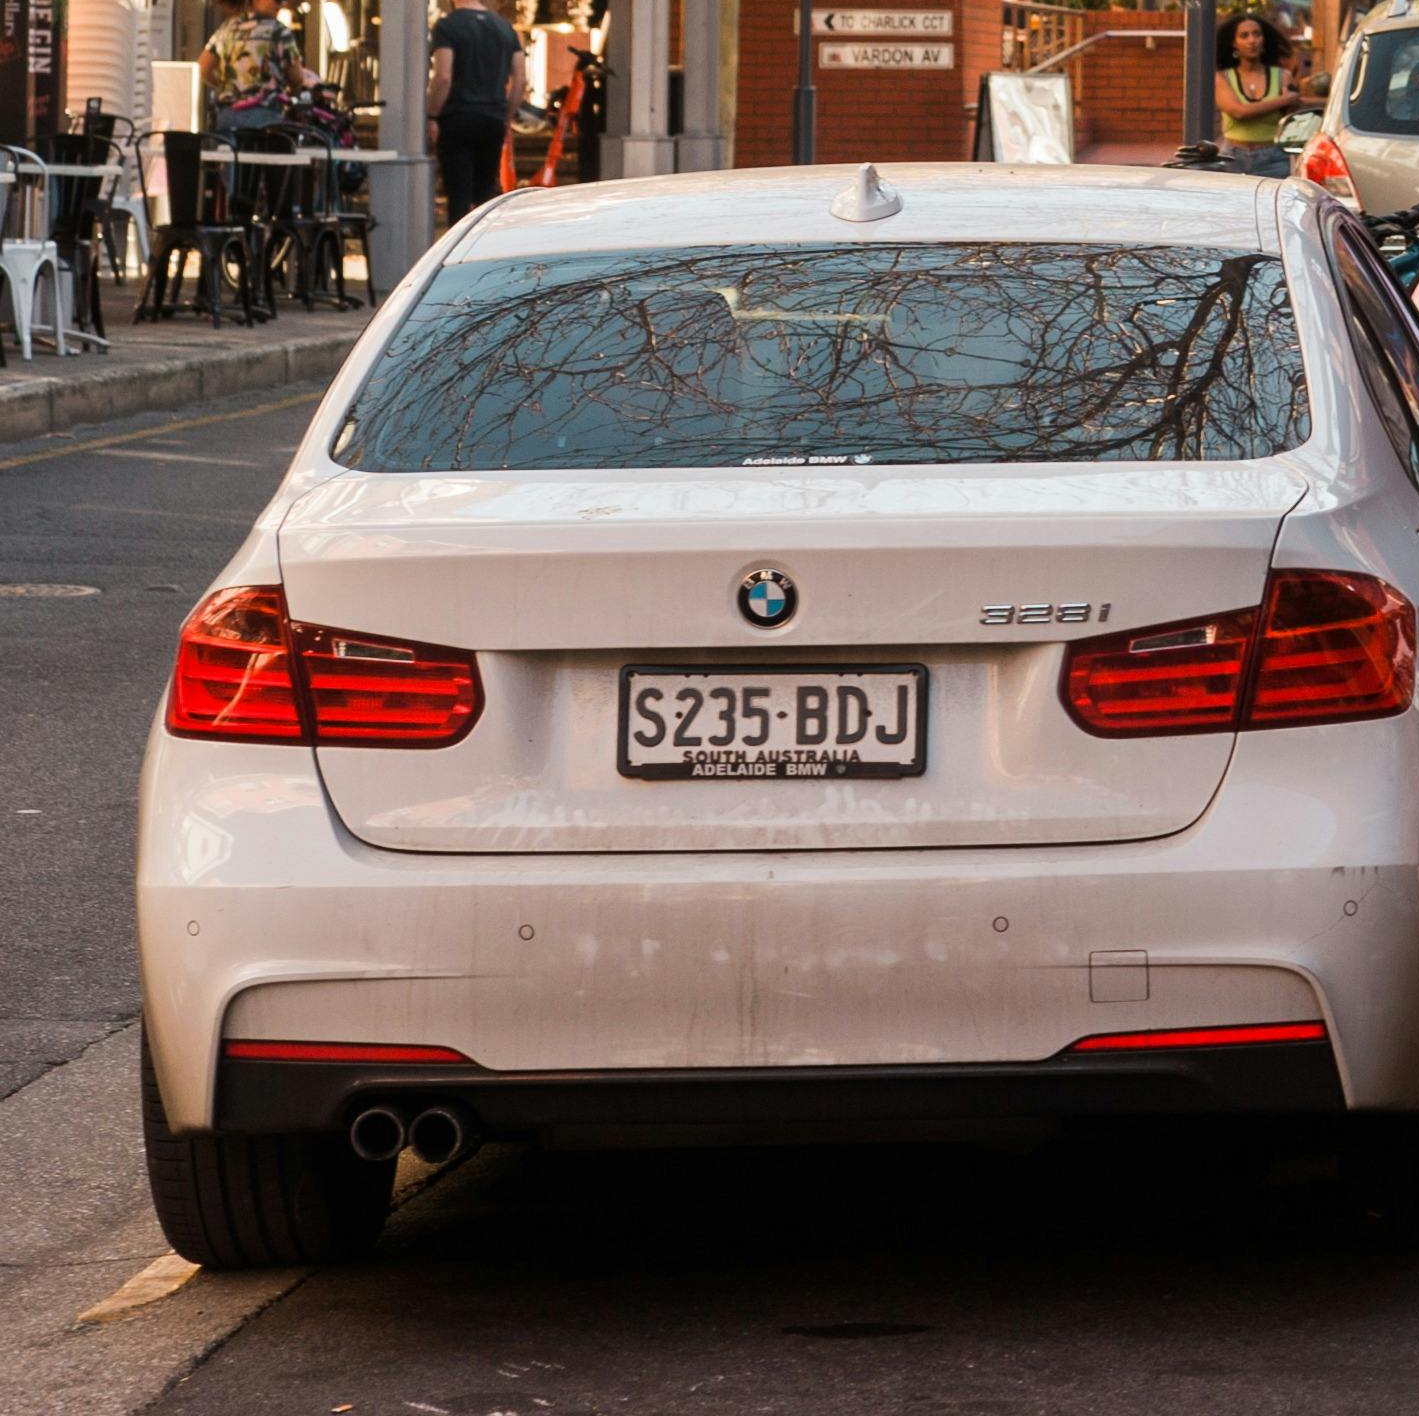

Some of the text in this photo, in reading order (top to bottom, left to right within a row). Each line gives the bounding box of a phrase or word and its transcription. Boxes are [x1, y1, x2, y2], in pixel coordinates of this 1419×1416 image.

[841, 15, 945, 29] TO CHARLICK CCT
[28, 28, 52, 74] GIN
[852, 48, 943, 64] VARDON AV
[742, 455, 848, 466] Adelaide BMW
[683, 750, 861, 764] SOUTH AUSTRALIA
[691, 763, 827, 777] ADELAIDE BMW
